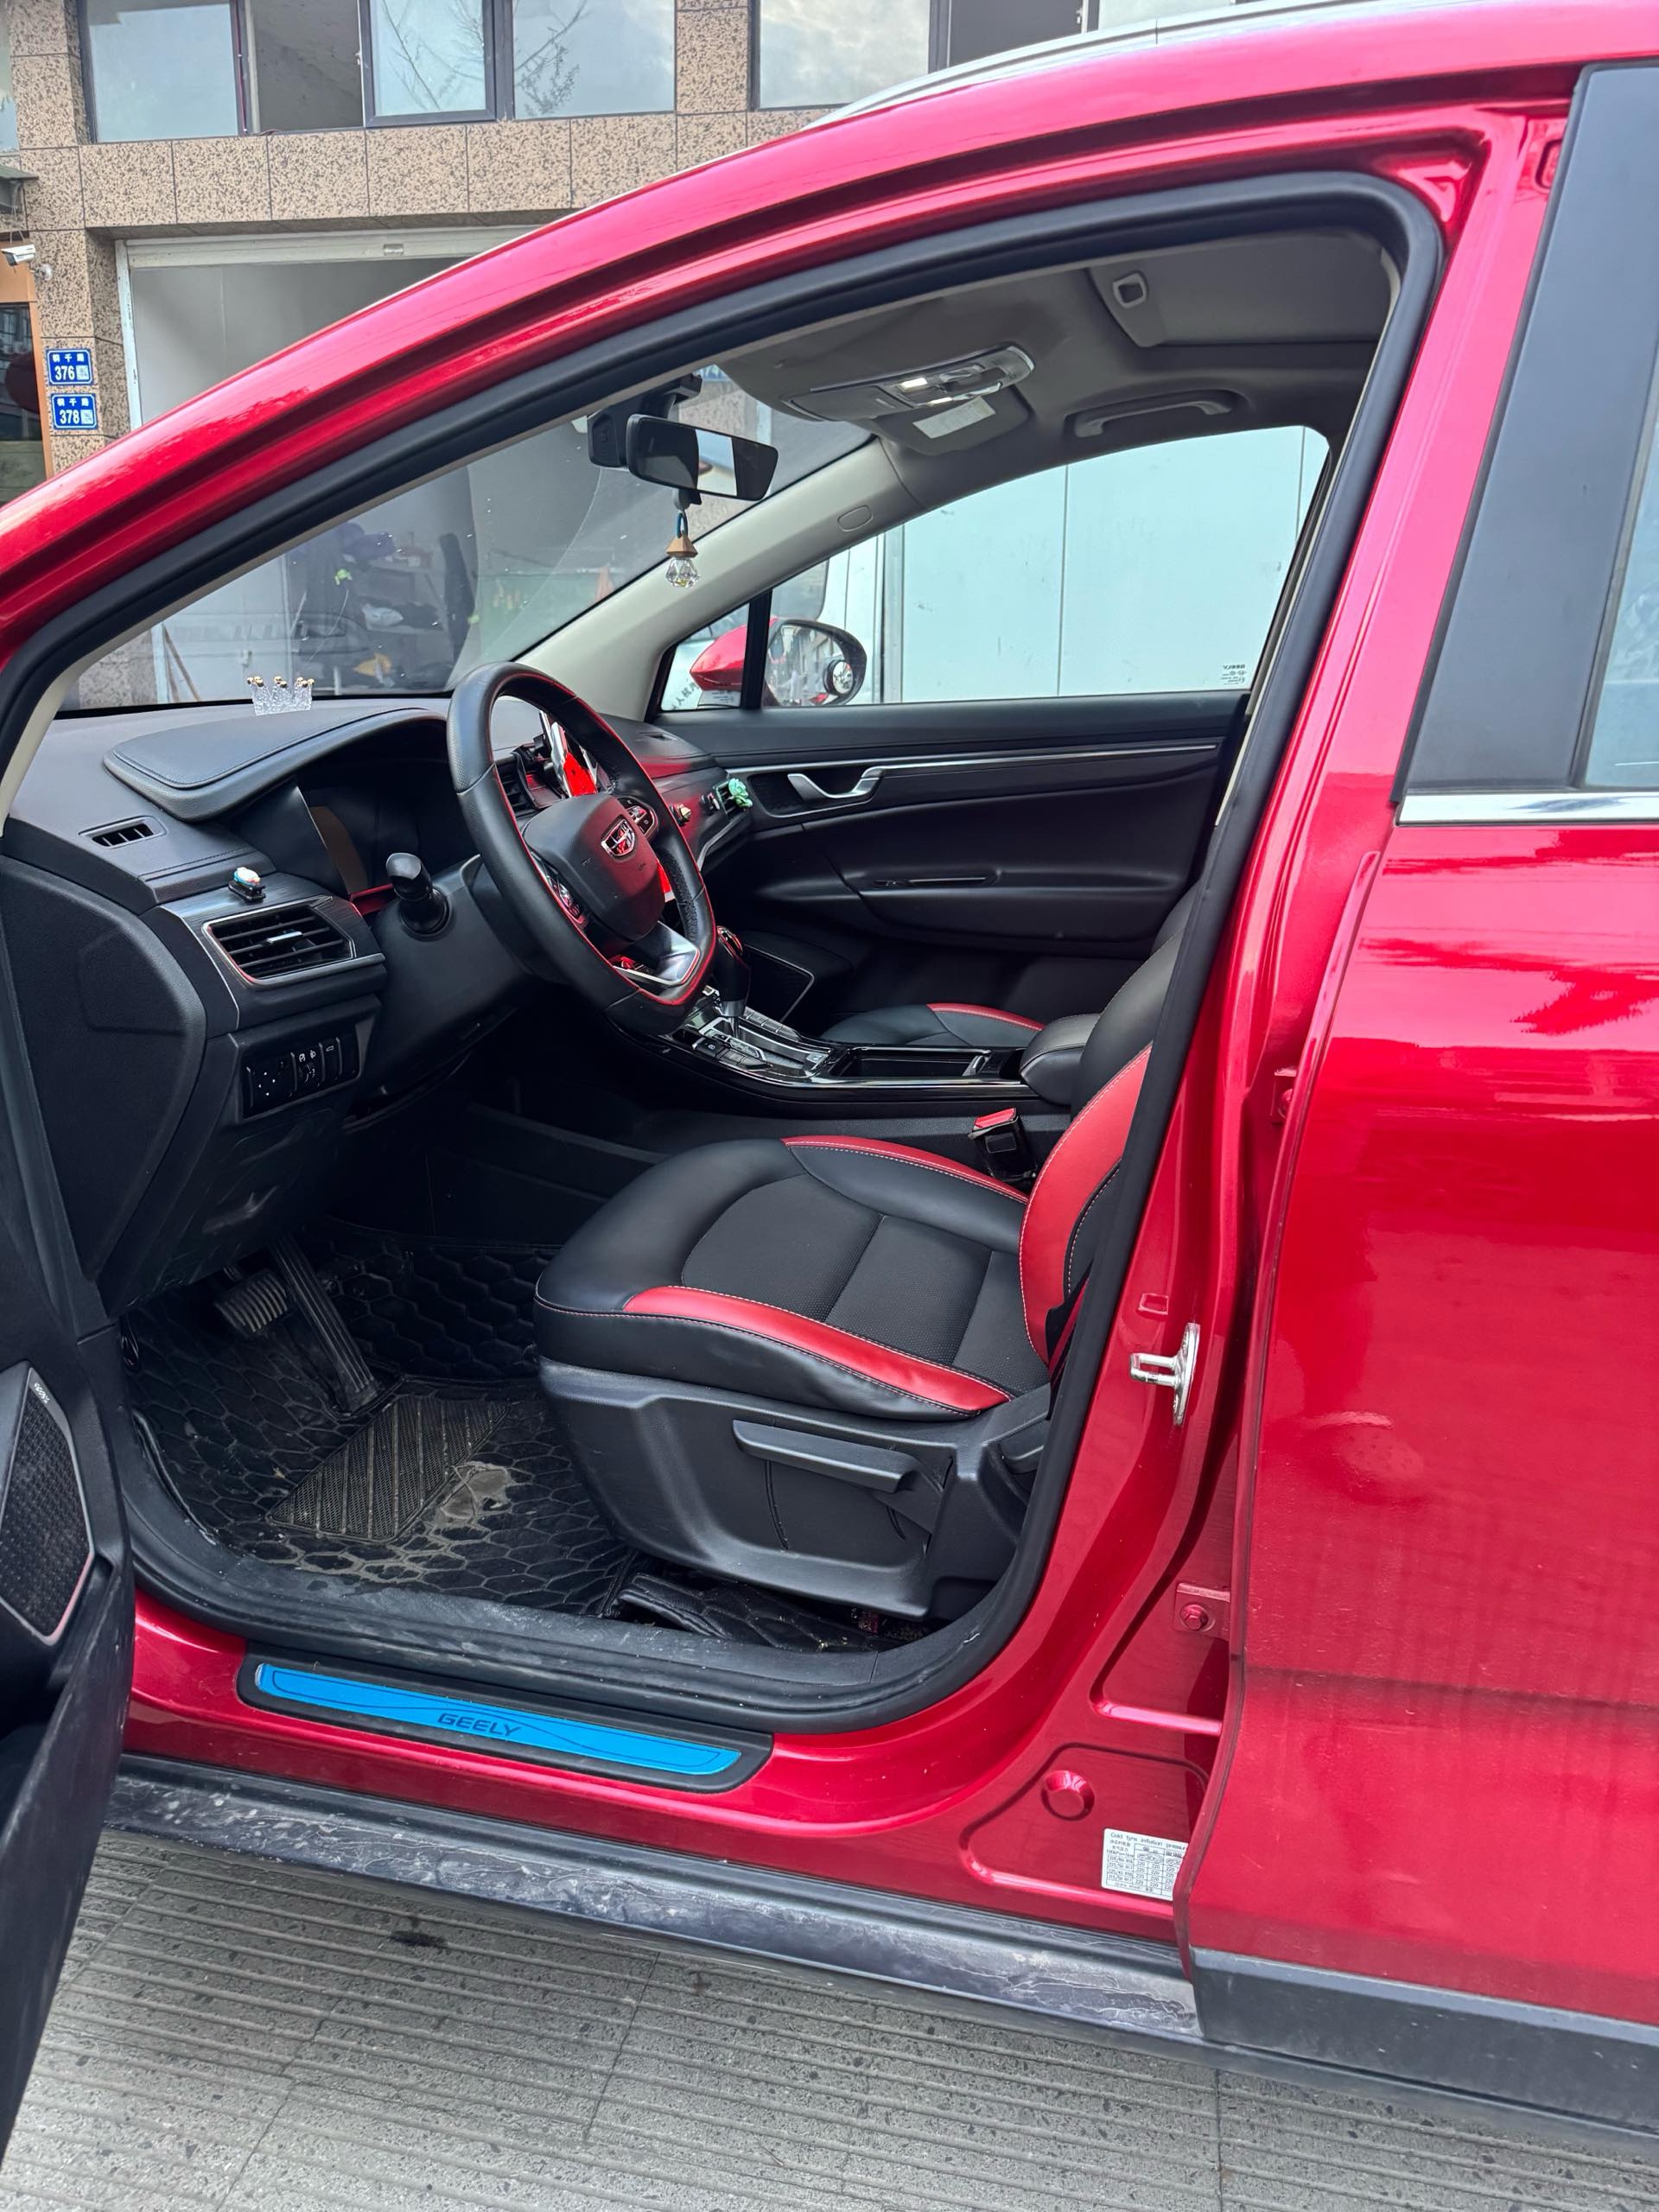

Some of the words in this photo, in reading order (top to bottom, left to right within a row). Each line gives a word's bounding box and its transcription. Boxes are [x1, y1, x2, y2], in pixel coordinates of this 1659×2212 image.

[55, 365, 75, 380] 376
[60, 410, 79, 424] 378
[437, 1713, 523, 1737] GEELY
